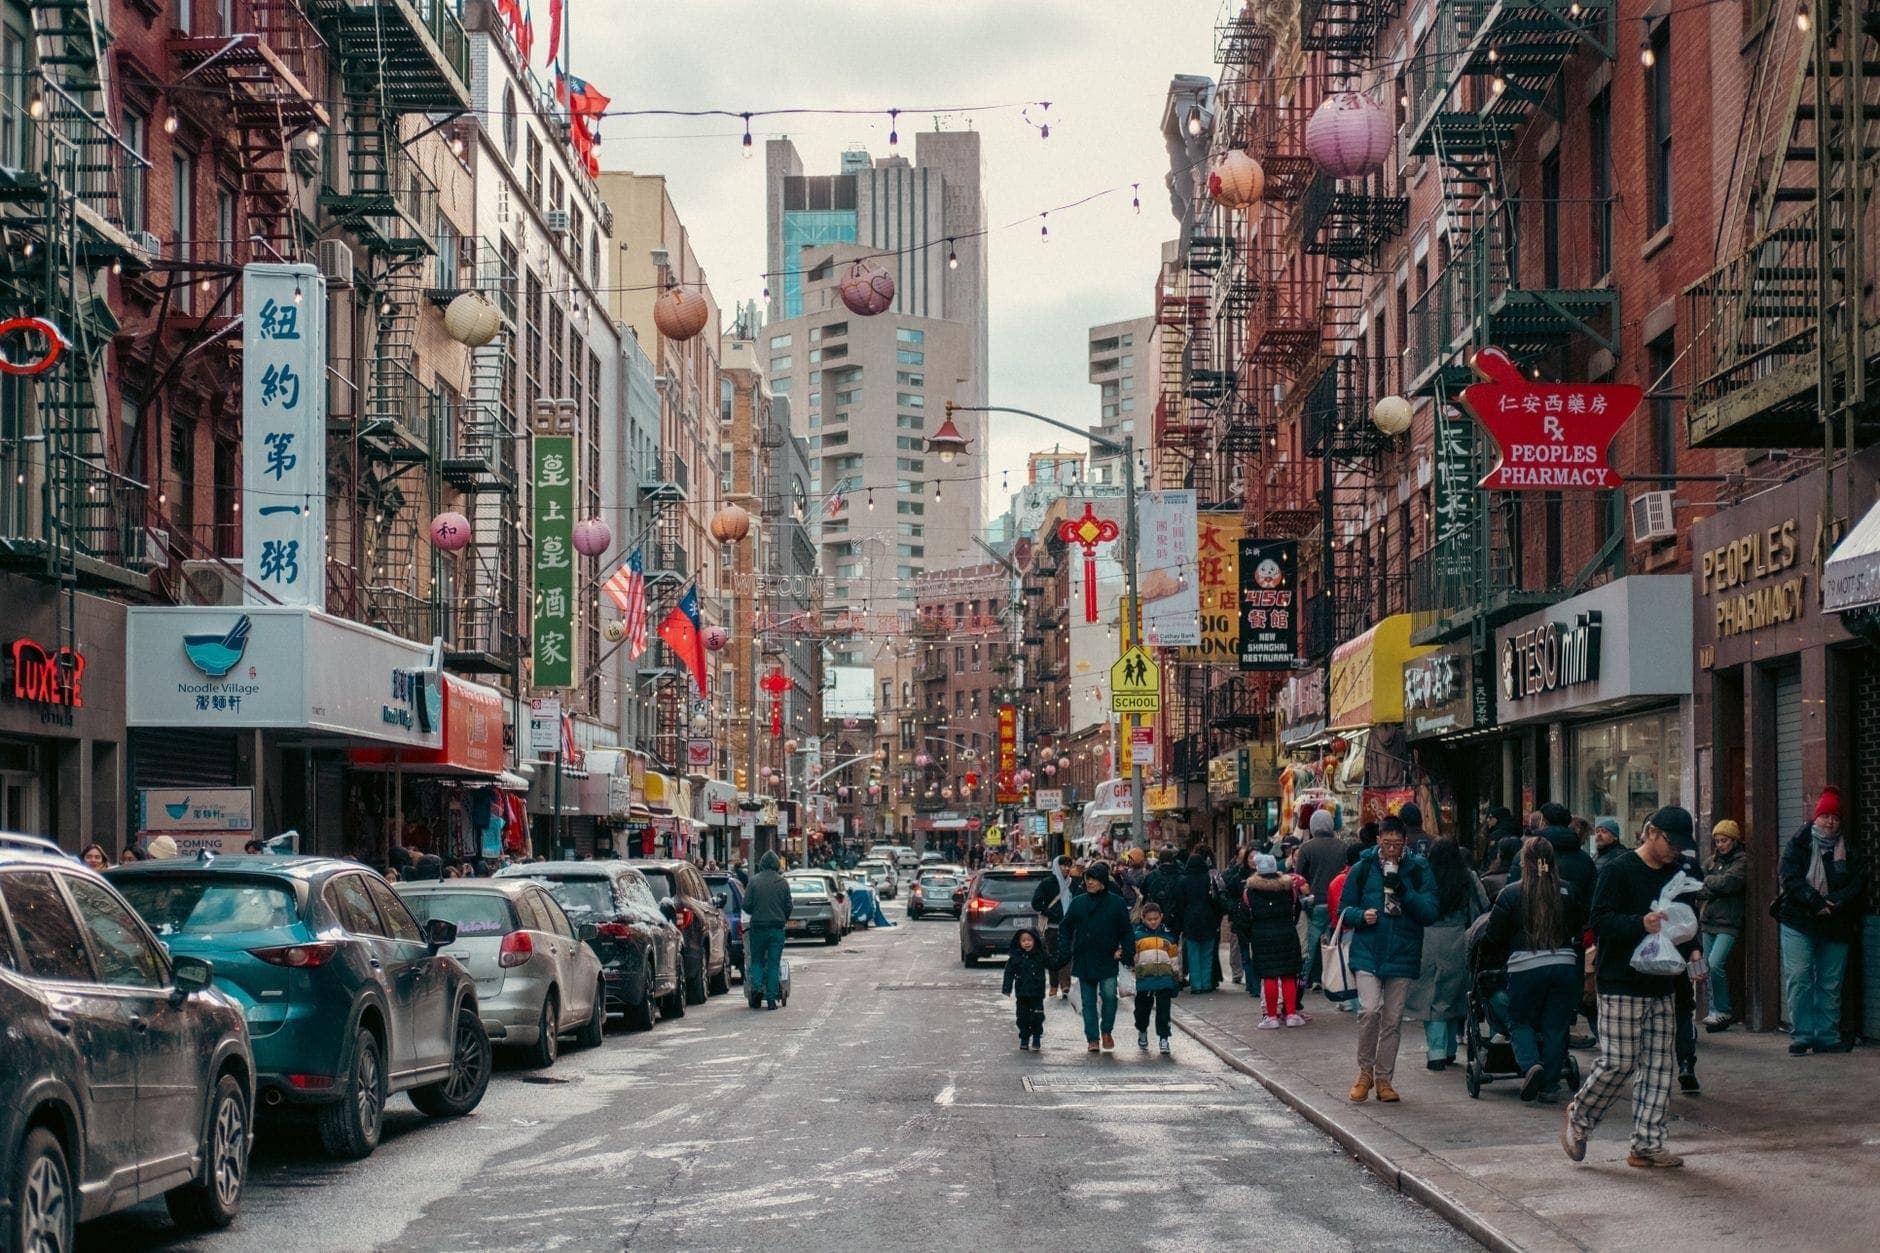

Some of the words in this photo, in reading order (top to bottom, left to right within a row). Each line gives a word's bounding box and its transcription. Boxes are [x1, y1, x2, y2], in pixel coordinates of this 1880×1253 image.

[1500, 394, 1608, 415] 仁安西藥房
[259, 297, 300, 585] 紐約第一粥
[1511, 444, 1597, 463] PEOPLES
[1499, 466, 1608, 487] PHARMACY
[437, 522, 457, 539] 和
[1702, 518, 1798, 597] PEOPLES
[733, 574, 835, 598] WELCOME
[1244, 590, 1292, 607] 456
[1715, 576, 1807, 640] PHARMACY
[1247, 609, 1290, 630] 餐館
[1258, 632, 1276, 642] NEW
[1247, 643, 1288, 652] SHANGHAI
[1515, 622, 1559, 698] TESO
[1560, 610, 1590, 687] mini
[1242, 653, 1295, 663] RESTAURANT
[178, 683, 219, 693] Noodle
[220, 683, 260, 695] Village
[195, 694, 242, 714] 粥麵軒
[1115, 697, 1157, 708] SCHOOL
[177, 840, 222, 848] COMING
